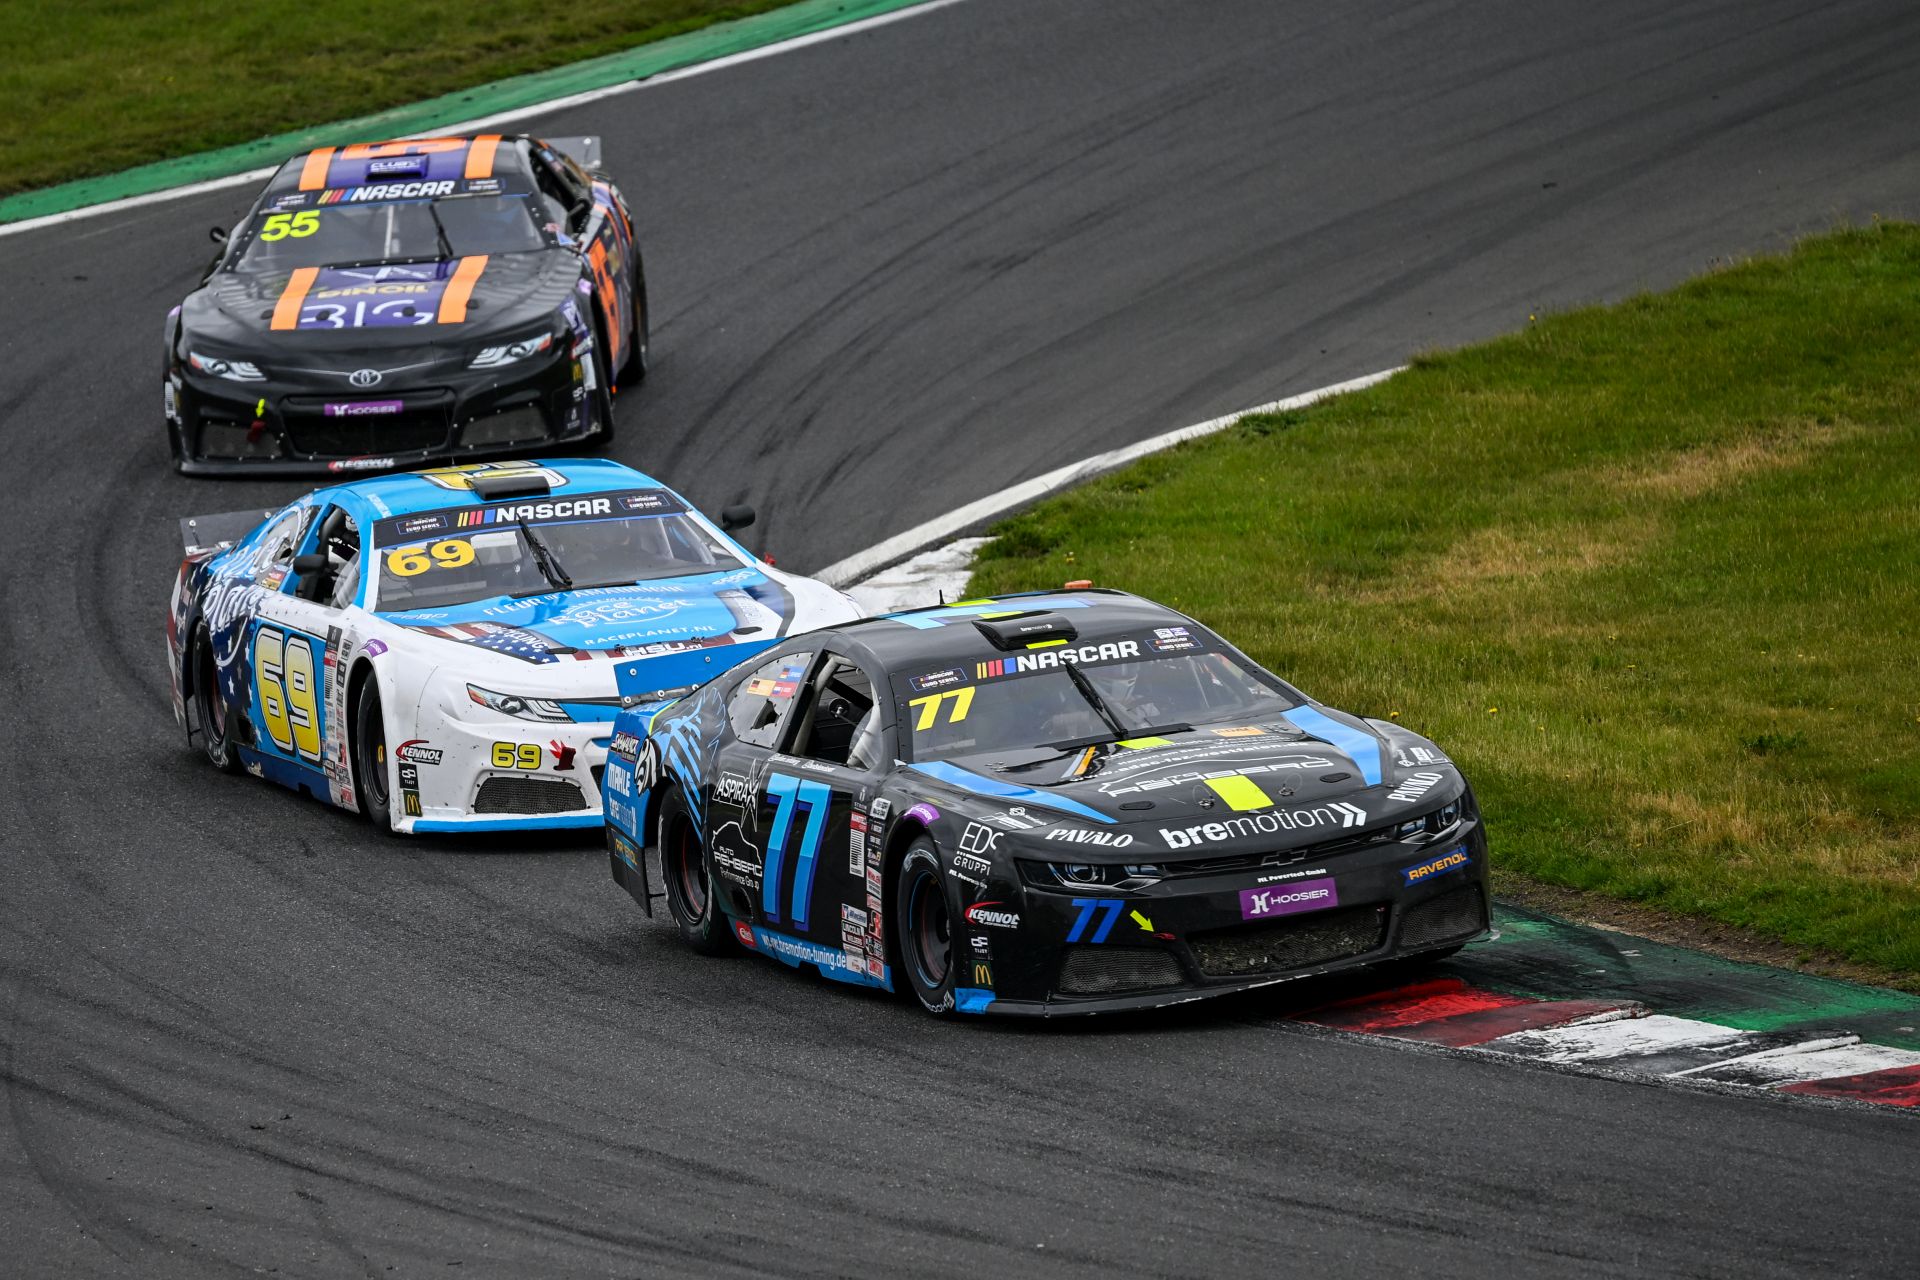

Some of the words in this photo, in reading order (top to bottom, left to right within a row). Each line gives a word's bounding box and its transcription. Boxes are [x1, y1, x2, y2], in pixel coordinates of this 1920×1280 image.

[350, 180, 455, 202] NASCAR
[260, 210, 320, 242] 55
[496, 498, 611, 523] NASCAR
[387, 540, 475, 577] 69
[483, 597, 545, 616] FLEUR
[547, 601, 632, 625] Race
[576, 599, 697, 628] Planet
[584, 625, 717, 645] RACEPLANET.NL
[1016, 640, 1140, 672] NASCAR
[254, 625, 324, 763] 69
[909, 687, 976, 731] 77
[400, 746, 441, 761] KENNOL
[491, 741, 542, 770] 69
[608, 762, 631, 798] MAHLE
[1044, 828, 1134, 848] PAVALO
[1158, 808, 1337, 849] bremotion
[713, 851, 763, 877] REHBERG
[763, 773, 833, 929] 77
[953, 856, 991, 876] GRUPPI
[1408, 852, 1467, 880] RAVENOL
[1271, 888, 1329, 905] HOOSIER
[1065, 899, 1126, 943] 77
